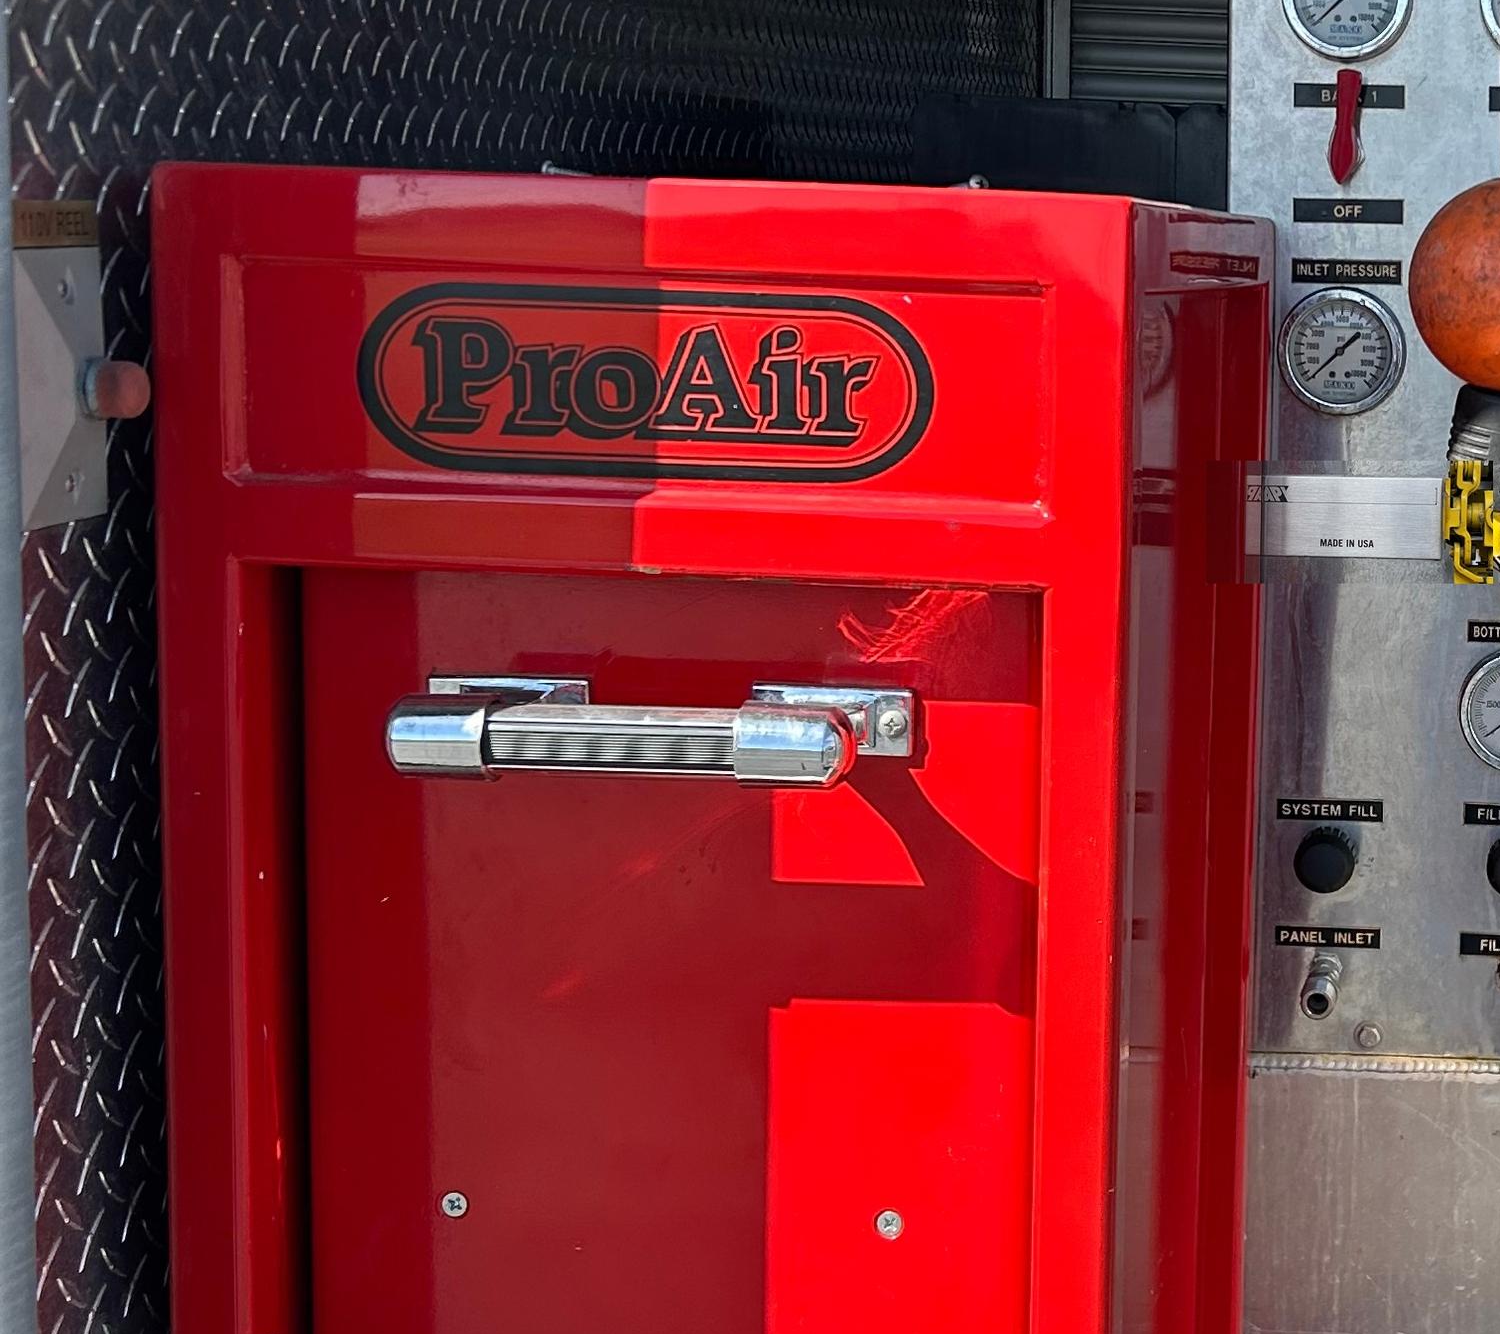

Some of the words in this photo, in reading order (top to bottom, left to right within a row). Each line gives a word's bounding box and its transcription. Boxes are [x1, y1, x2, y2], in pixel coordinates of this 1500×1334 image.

[1372, 91, 1377, 103] 1
[1333, 205, 1362, 218] OFF
[56, 212, 88, 236] REEL
[1296, 264, 1329, 277] INLET
[1335, 264, 1397, 278] PRESSURE
[412, 317, 880, 446] ProAir
[1320, 539, 1343, 548] MADE
[1346, 539, 1355, 548] IN
[1358, 540, 1374, 548] USA
[1281, 803, 1341, 817] SYSTEM
[1349, 804, 1377, 817] FILL
[1280, 931, 1326, 943] PANEL
[1334, 932, 1374, 945] INLET
